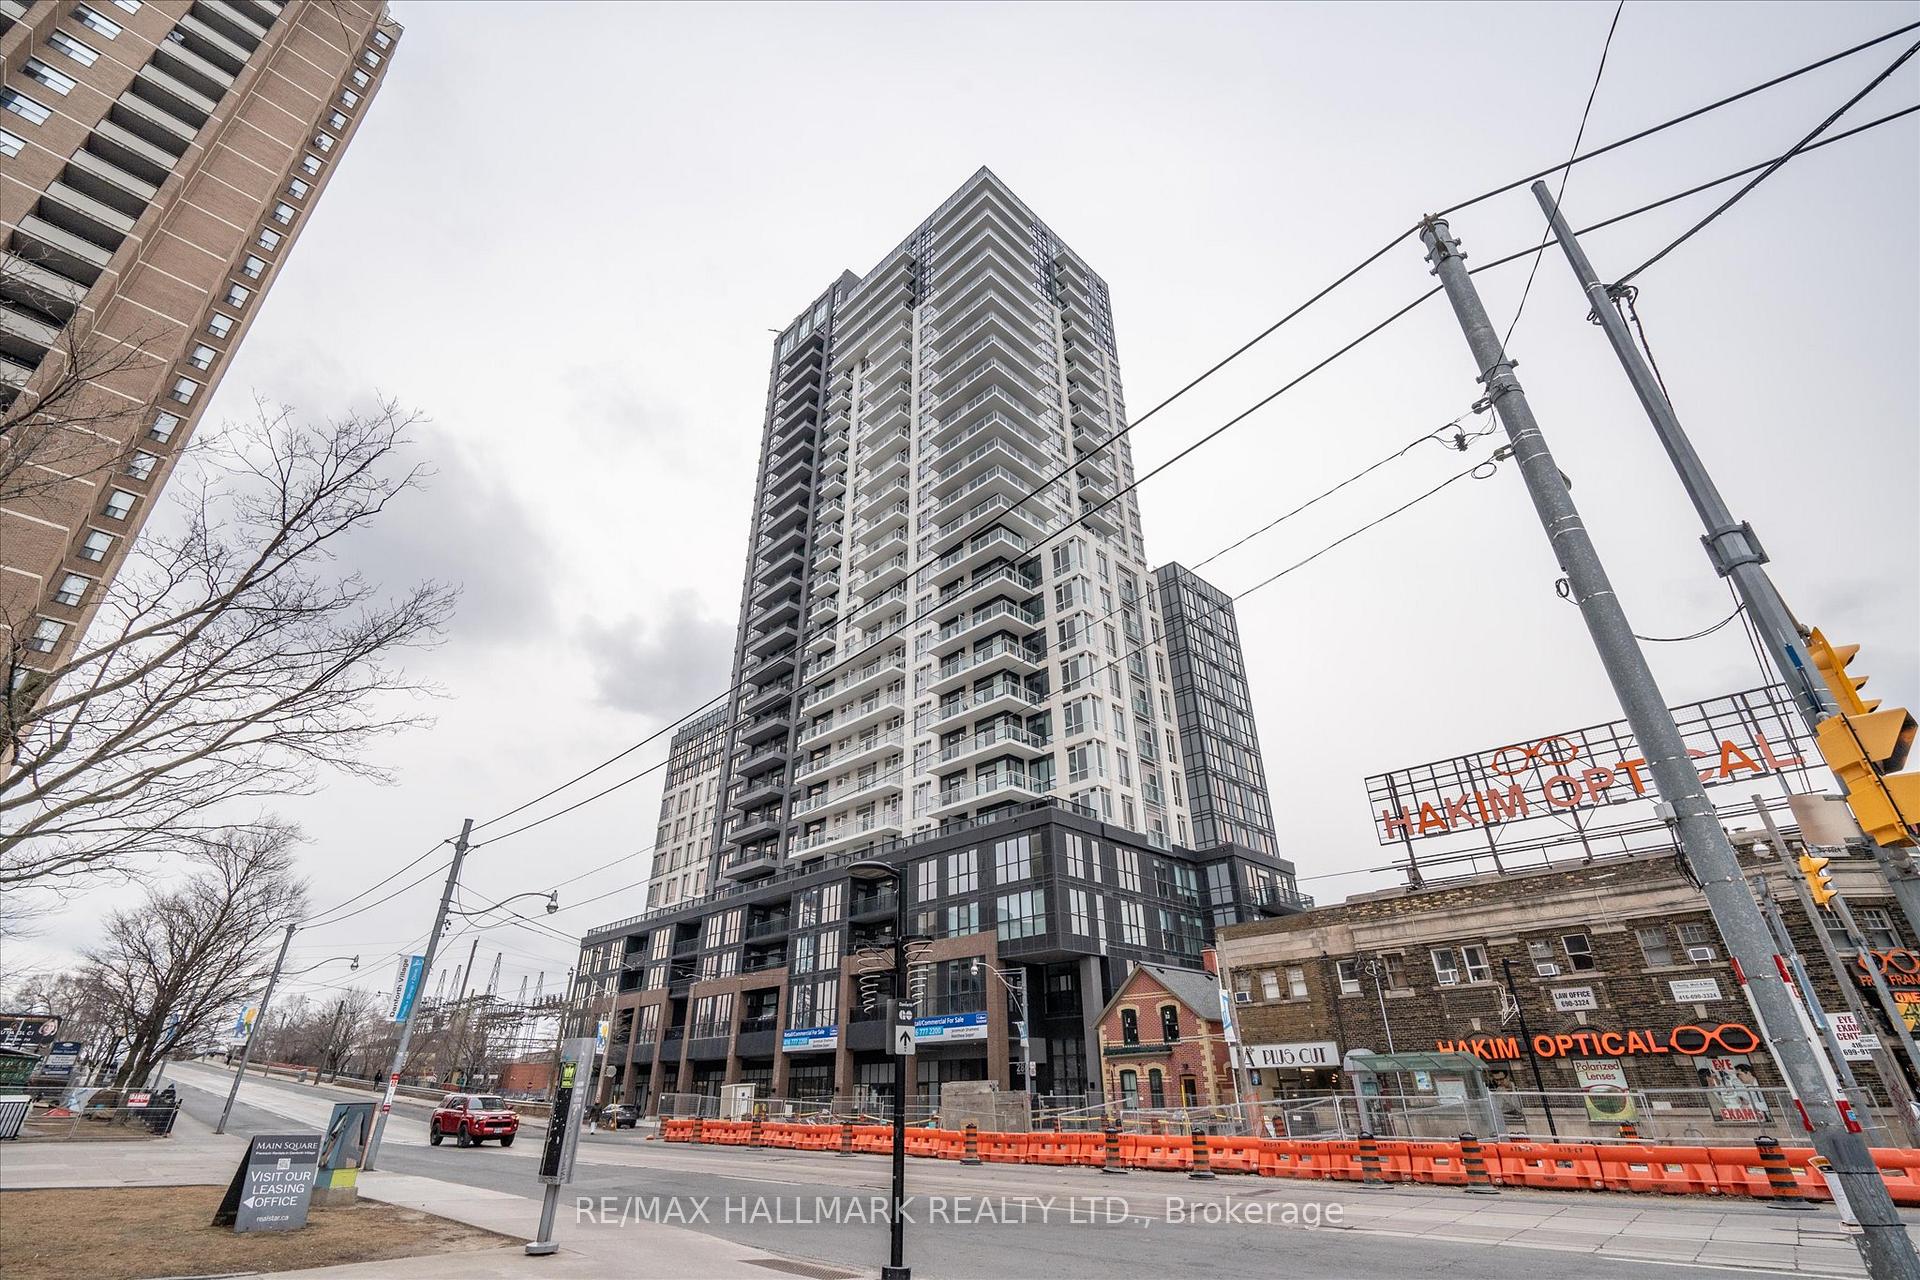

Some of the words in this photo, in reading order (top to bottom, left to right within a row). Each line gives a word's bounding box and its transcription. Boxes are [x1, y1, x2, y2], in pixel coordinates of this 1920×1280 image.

[1382, 784, 1530, 839] HAKIM
[1545, 733, 1806, 807] OPTCAL
[389, 984, 402, 1018] Danforth
[399, 958, 409, 983] Village
[1569, 990, 1591, 998] OFFICE
[1561, 999, 1590, 1007] 690-3324
[898, 1010, 913, 1020] GO
[1836, 1032, 1861, 1041] CENT
[1436, 1035, 1521, 1059] HAKIM
[1533, 1029, 1670, 1058] OPTICAL
[1262, 1048, 1295, 1065] PLUS
[1298, 1047, 1326, 1064] CUT
[1574, 1060, 1620, 1071] Polarized
[1712, 1058, 1734, 1070] EYE
[1585, 1071, 1616, 1081] Lenses
[1720, 1107, 1763, 1120] EXAMS
[256, 1142, 282, 1150] MAIN
[283, 1141, 319, 1151] SQUARE
[251, 1171, 283, 1182] VISIT
[285, 1171, 311, 1181] OUR
[252, 1183, 305, 1195] LEASING
[254, 1196, 298, 1208] OFFICE
